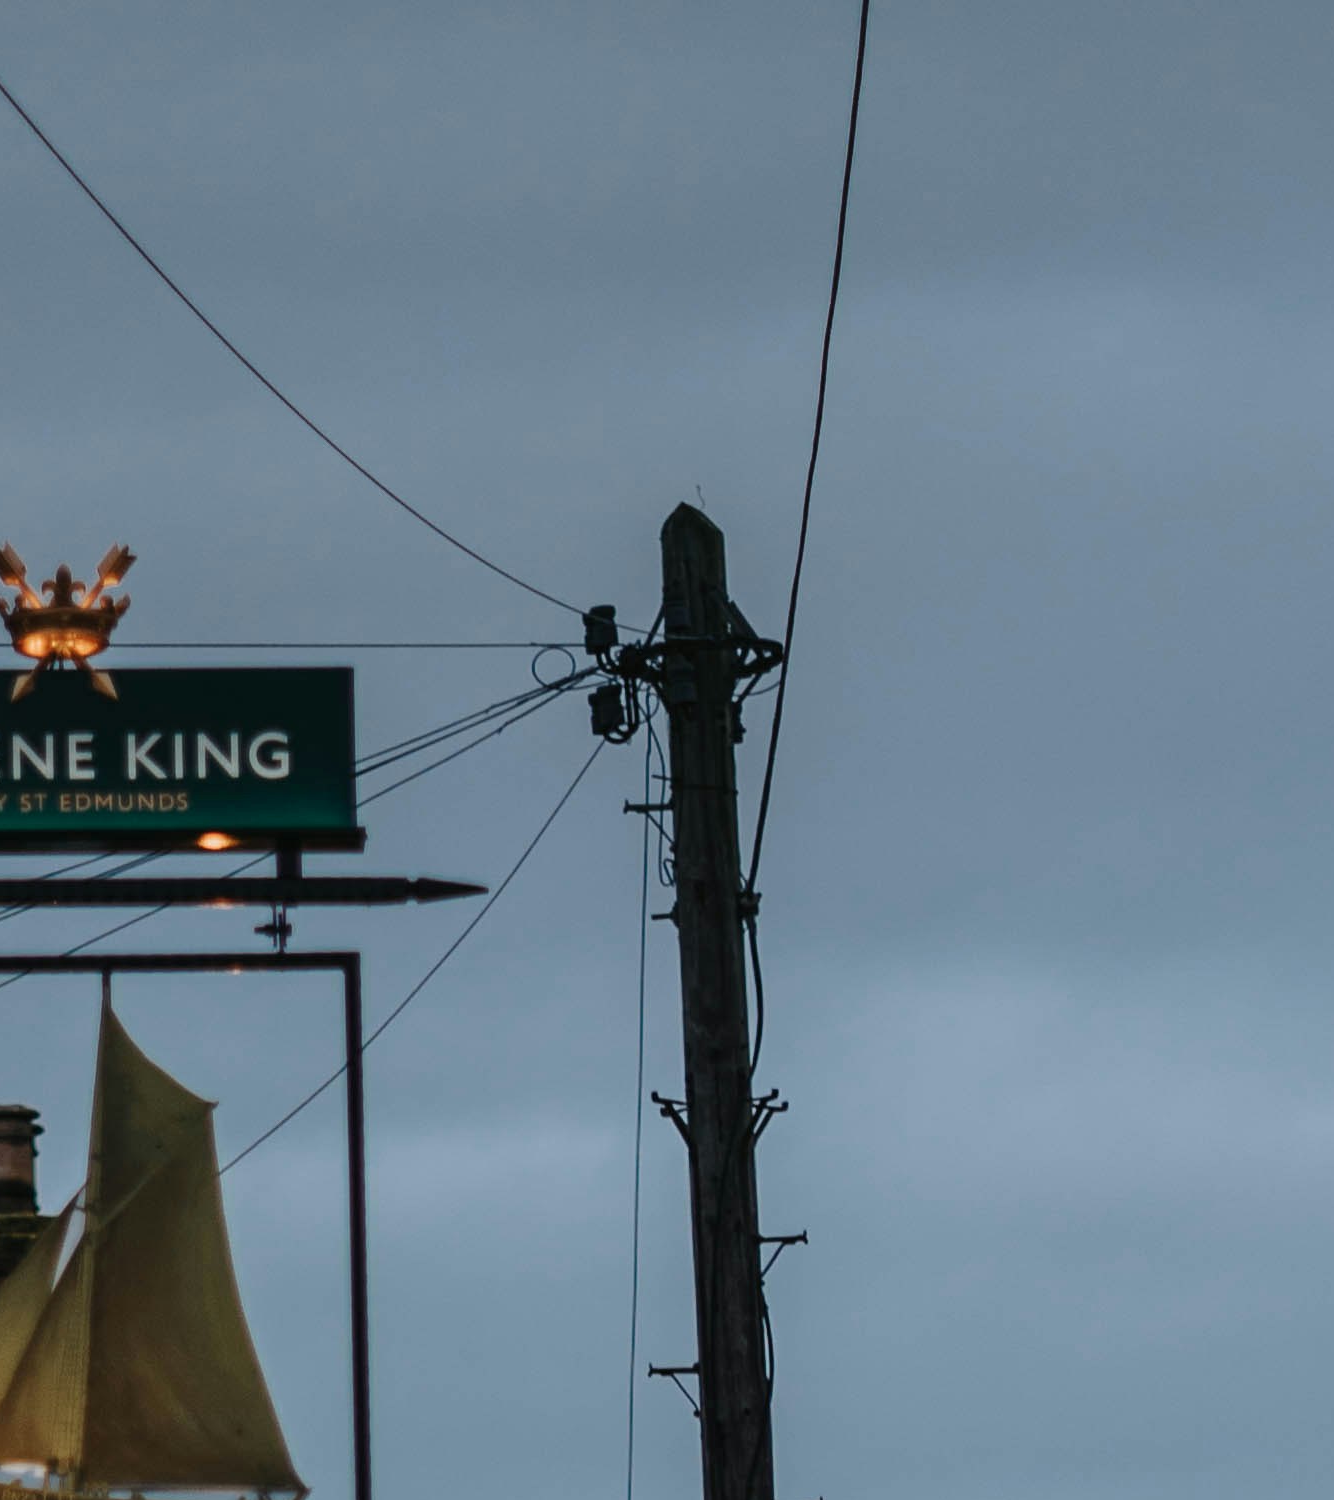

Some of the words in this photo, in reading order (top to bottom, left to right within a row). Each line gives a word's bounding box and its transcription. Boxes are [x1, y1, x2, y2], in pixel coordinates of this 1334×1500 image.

[127, 730, 292, 780] KING
[18, 792, 49, 813] ST
[58, 791, 190, 814] EDMUNDS
